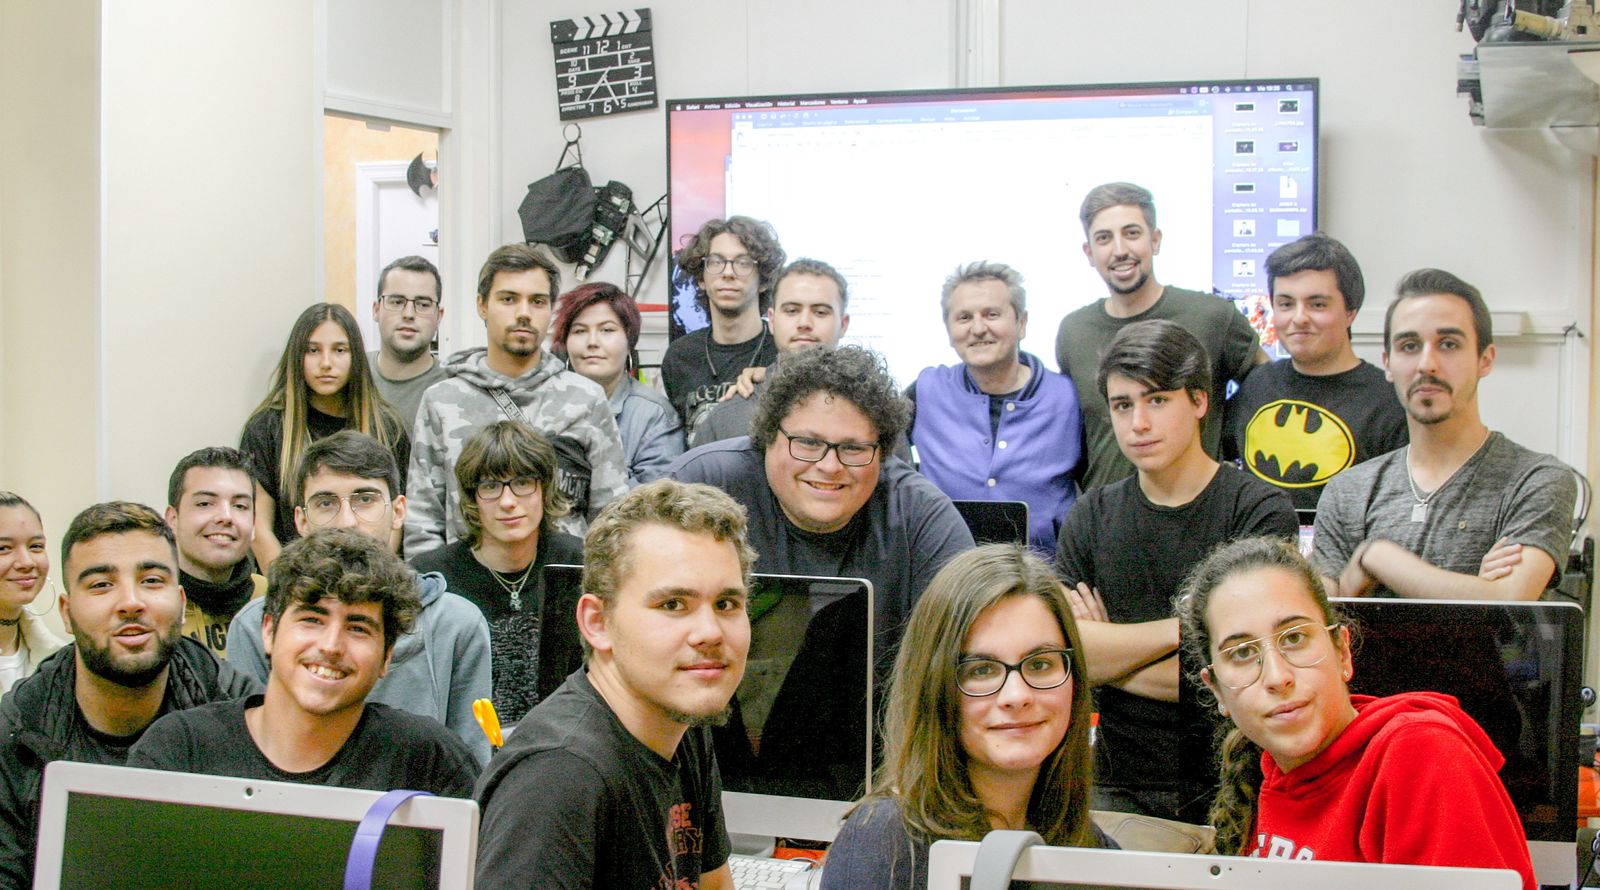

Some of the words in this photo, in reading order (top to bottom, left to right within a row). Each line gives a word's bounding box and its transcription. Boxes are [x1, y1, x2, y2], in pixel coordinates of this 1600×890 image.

[560, 46, 578, 55] SCENE
[582, 45, 590, 55] 11
[596, 39, 609, 54] 12
[616, 40, 621, 50] 1
[633, 65, 642, 80] 3
[568, 74, 577, 89] 9
[561, 104, 586, 112] DIRECTOR
[588, 102, 595, 113] 7
[603, 99, 612, 114] 6
[620, 98, 627, 109] 5
